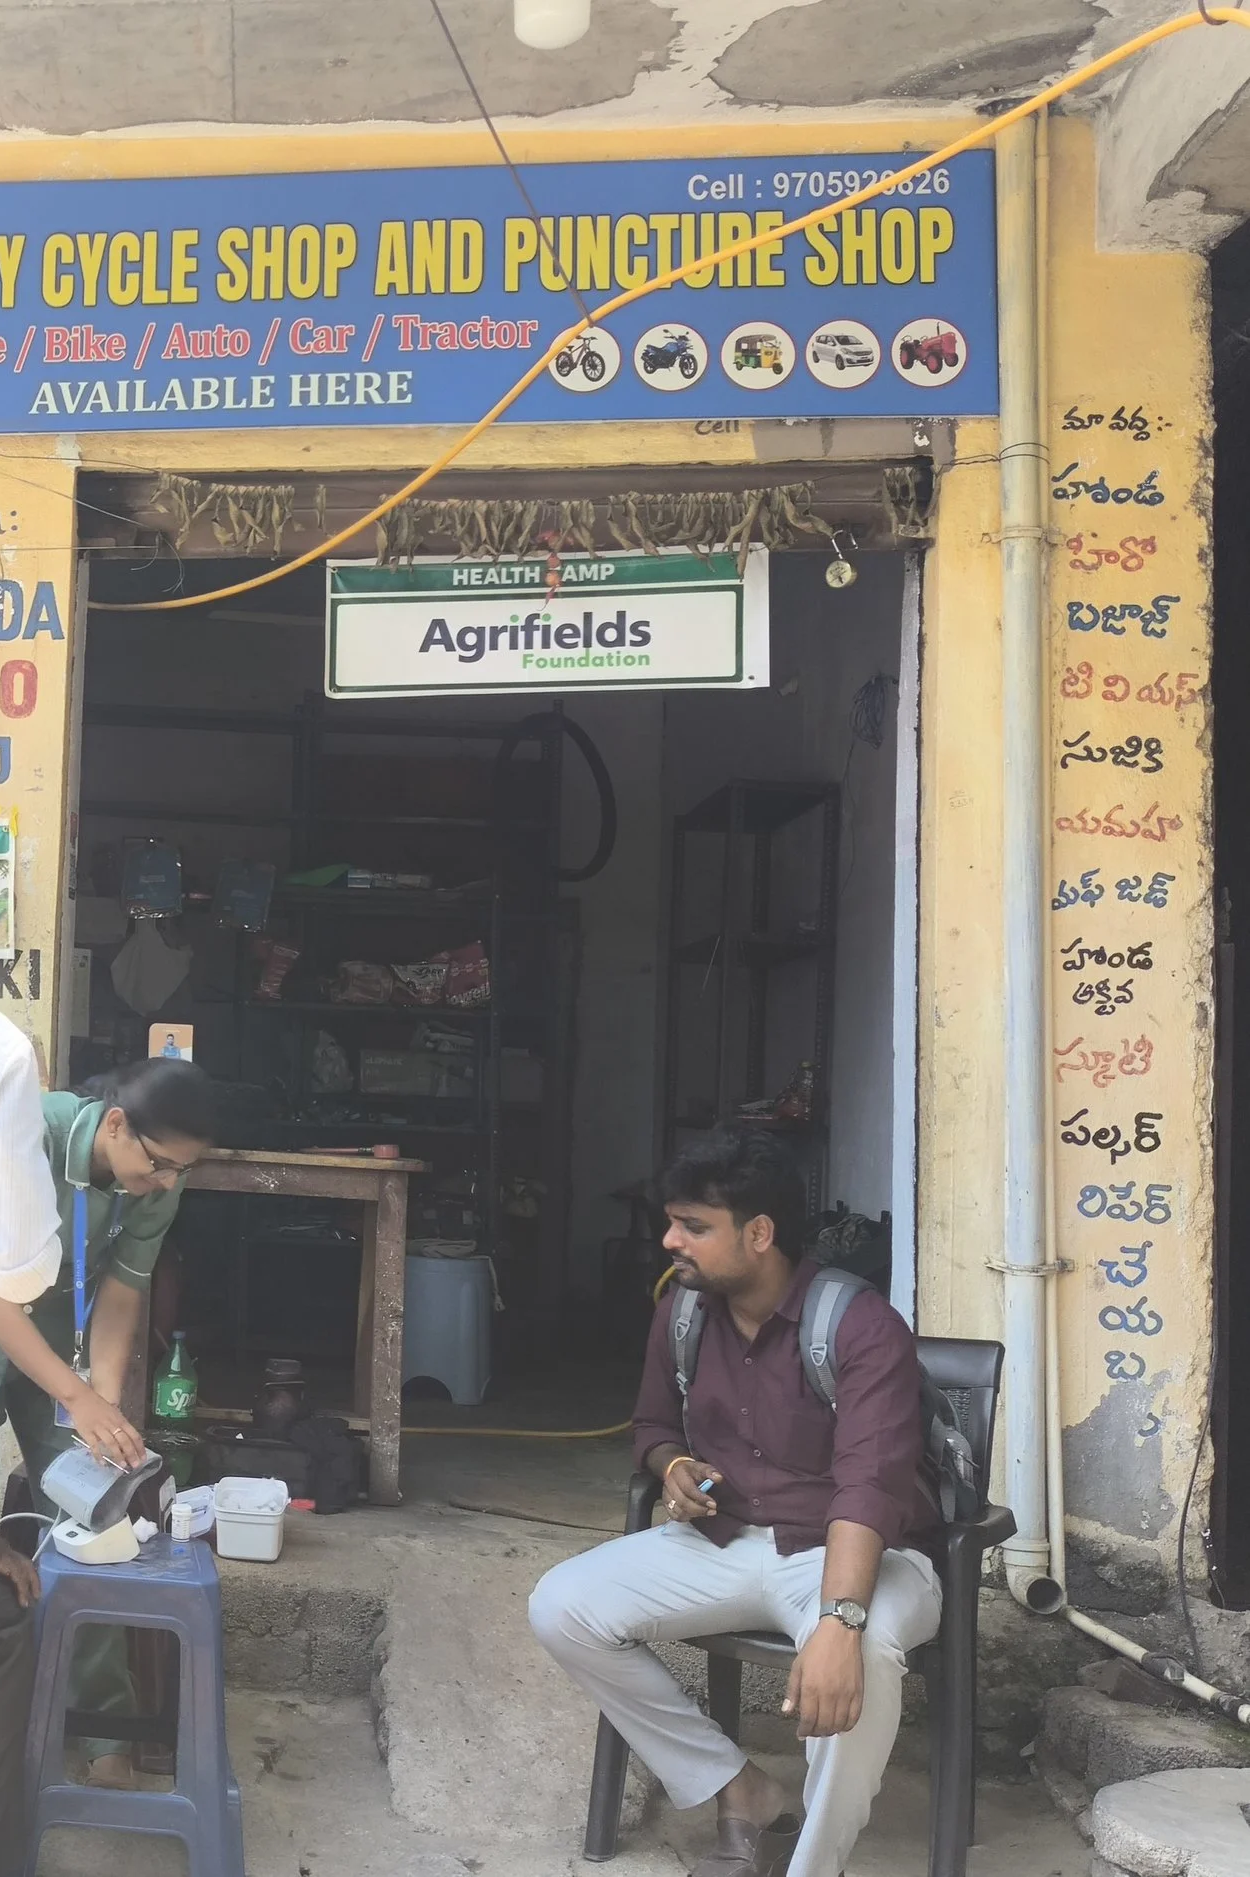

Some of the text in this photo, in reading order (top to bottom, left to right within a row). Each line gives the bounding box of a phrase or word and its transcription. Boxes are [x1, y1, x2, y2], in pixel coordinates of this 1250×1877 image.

[687, 173, 744, 200] Cell
[40, 228, 200, 308] CYCLE
[215, 223, 357, 303] SHOP
[373, 218, 485, 298] AND
[503, 210, 786, 293] PUNCTURE
[802, 205, 955, 286] SHOP
[44, 324, 127, 363] Bike
[161, 321, 251, 361] Auto
[288, 315, 355, 355] Car
[392, 313, 539, 351] Tractor
[28, 369, 414, 416] AVAILABLE HERE
[1061, 405, 1105, 431] మా
[452, 563, 615, 586] HEALTH AMP
[418, 610, 652, 664] Agrifields
[1066, 595, 1181, 639] బజాజ్
[522, 648, 651, 671] Foundation
[1060, 1108, 1164, 1166] పల్సర్
[1076, 1180, 1173, 1225] రిపేర్
